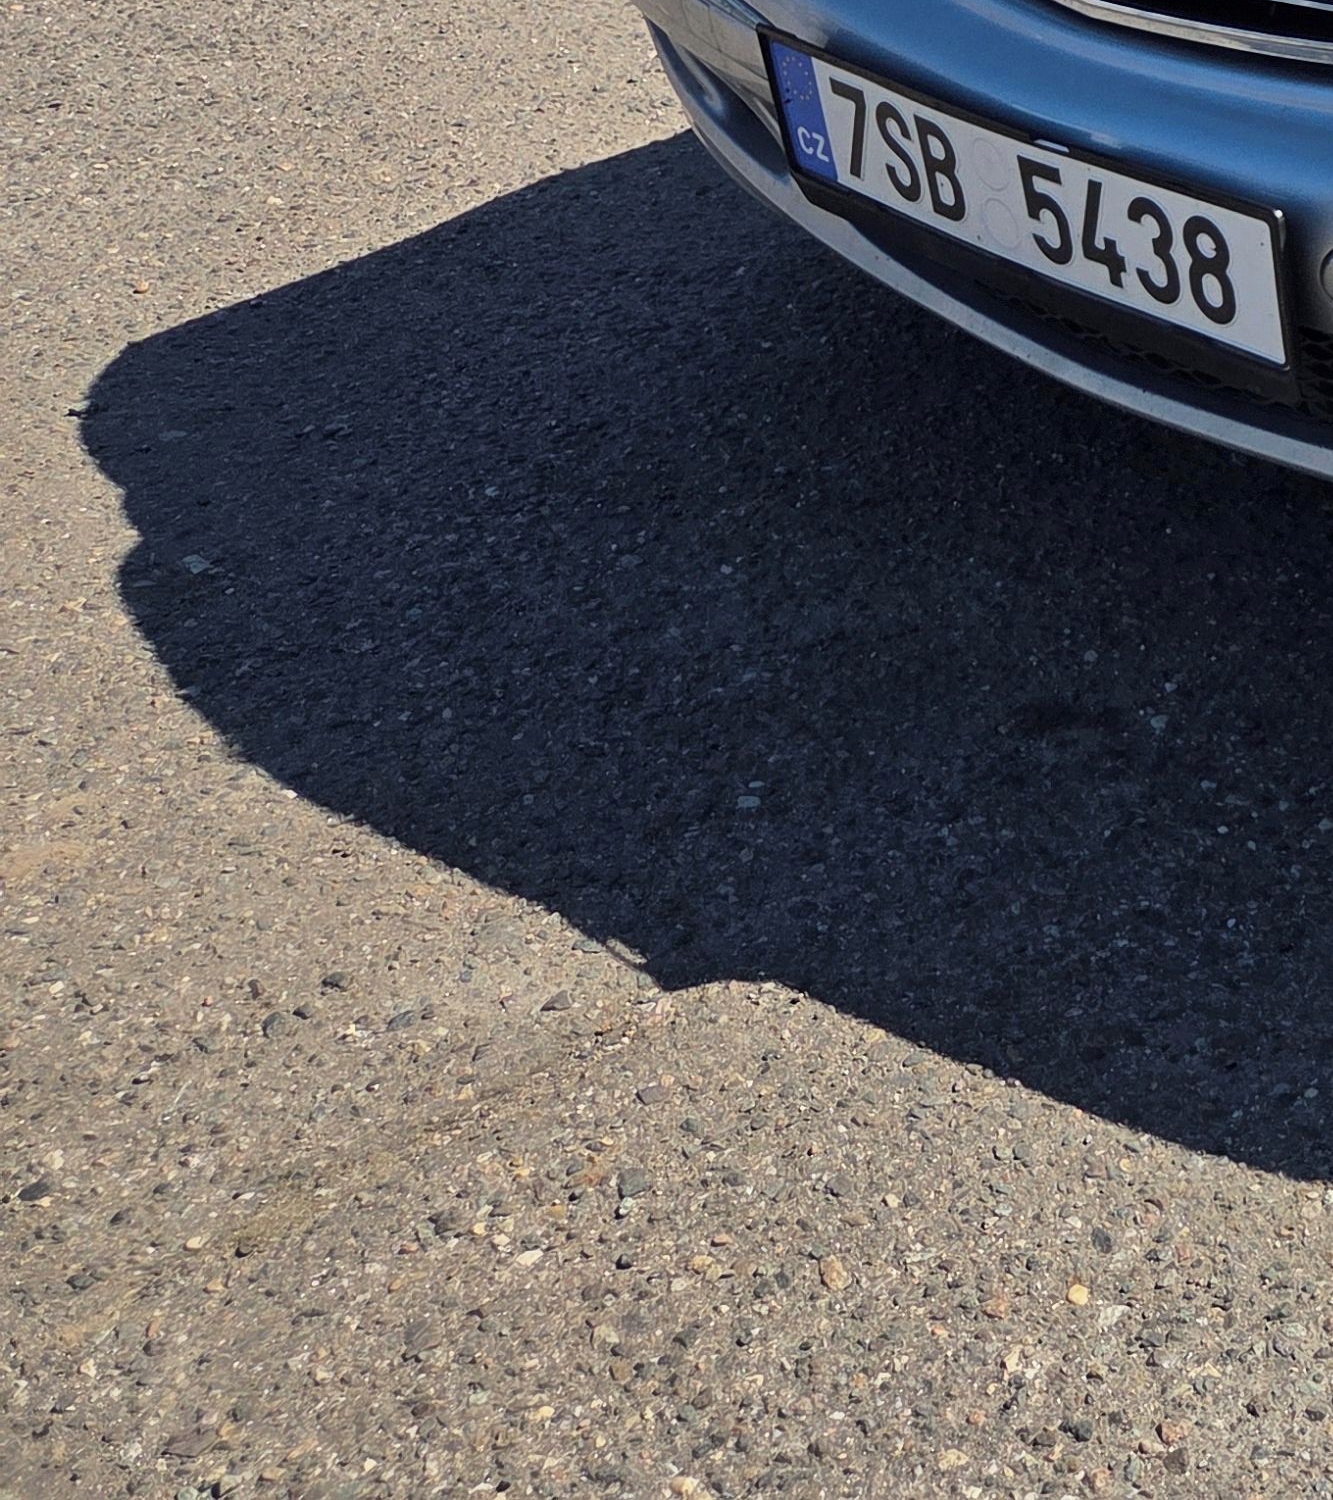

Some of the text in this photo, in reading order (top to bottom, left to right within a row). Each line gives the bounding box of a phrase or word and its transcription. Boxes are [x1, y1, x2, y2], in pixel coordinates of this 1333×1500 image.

[796, 124, 830, 164] CZ
[829, 76, 1238, 326] 7SB 5438
